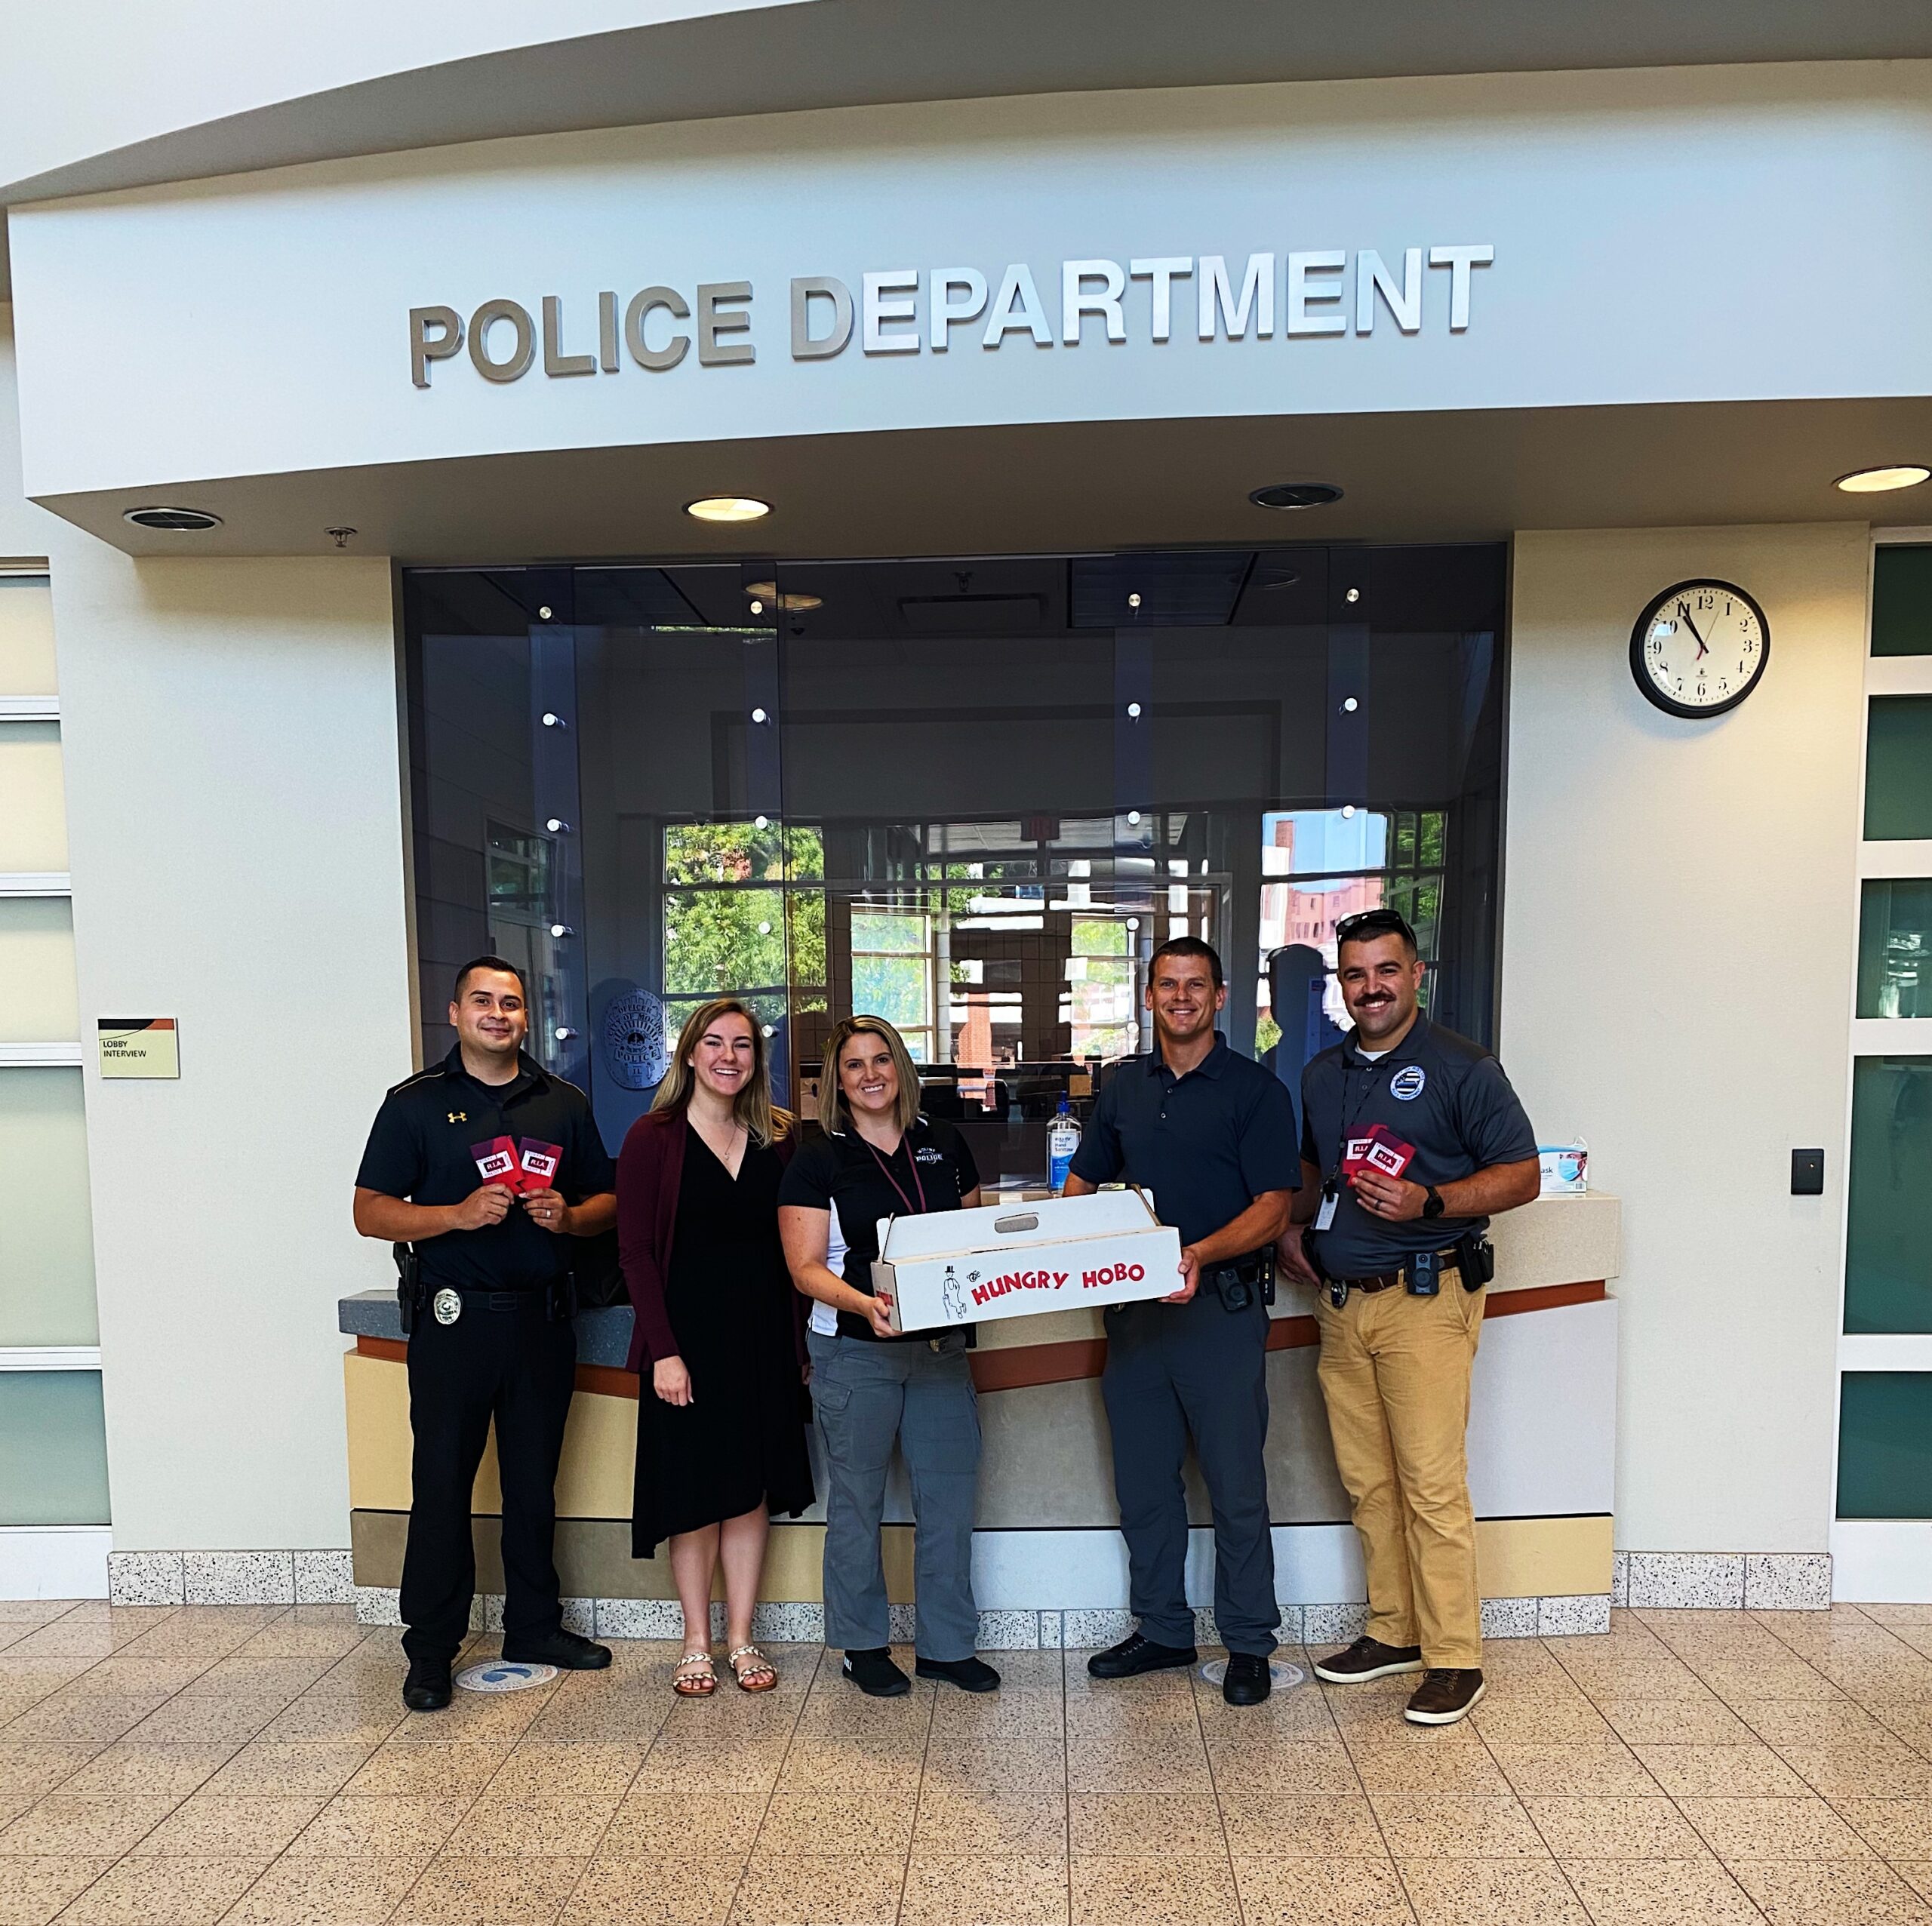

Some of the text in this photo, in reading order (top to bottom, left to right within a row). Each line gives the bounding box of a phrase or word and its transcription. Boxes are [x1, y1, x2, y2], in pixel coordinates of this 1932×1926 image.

[410, 244, 1494, 388] POLICE DEPARTMENT
[1697, 595, 1713, 610] 12
[1725, 602, 1731, 617] 1
[1740, 619, 1748, 632] 2
[1654, 641, 1662, 654] 9
[1743, 639, 1752, 653] 3
[1736, 660, 1744, 673] 4
[1677, 678, 1684, 691] 7
[1697, 682, 1706, 696] 6
[1718, 677, 1727, 691] 5
[618, 1004, 653, 1014] OFFICER
[617, 1049, 657, 1063] POLICE
[914, 1153, 944, 1162] POLICE
[971, 1270, 1069, 1306] HUNGRY
[1082, 1263, 1145, 1288] HOBO
